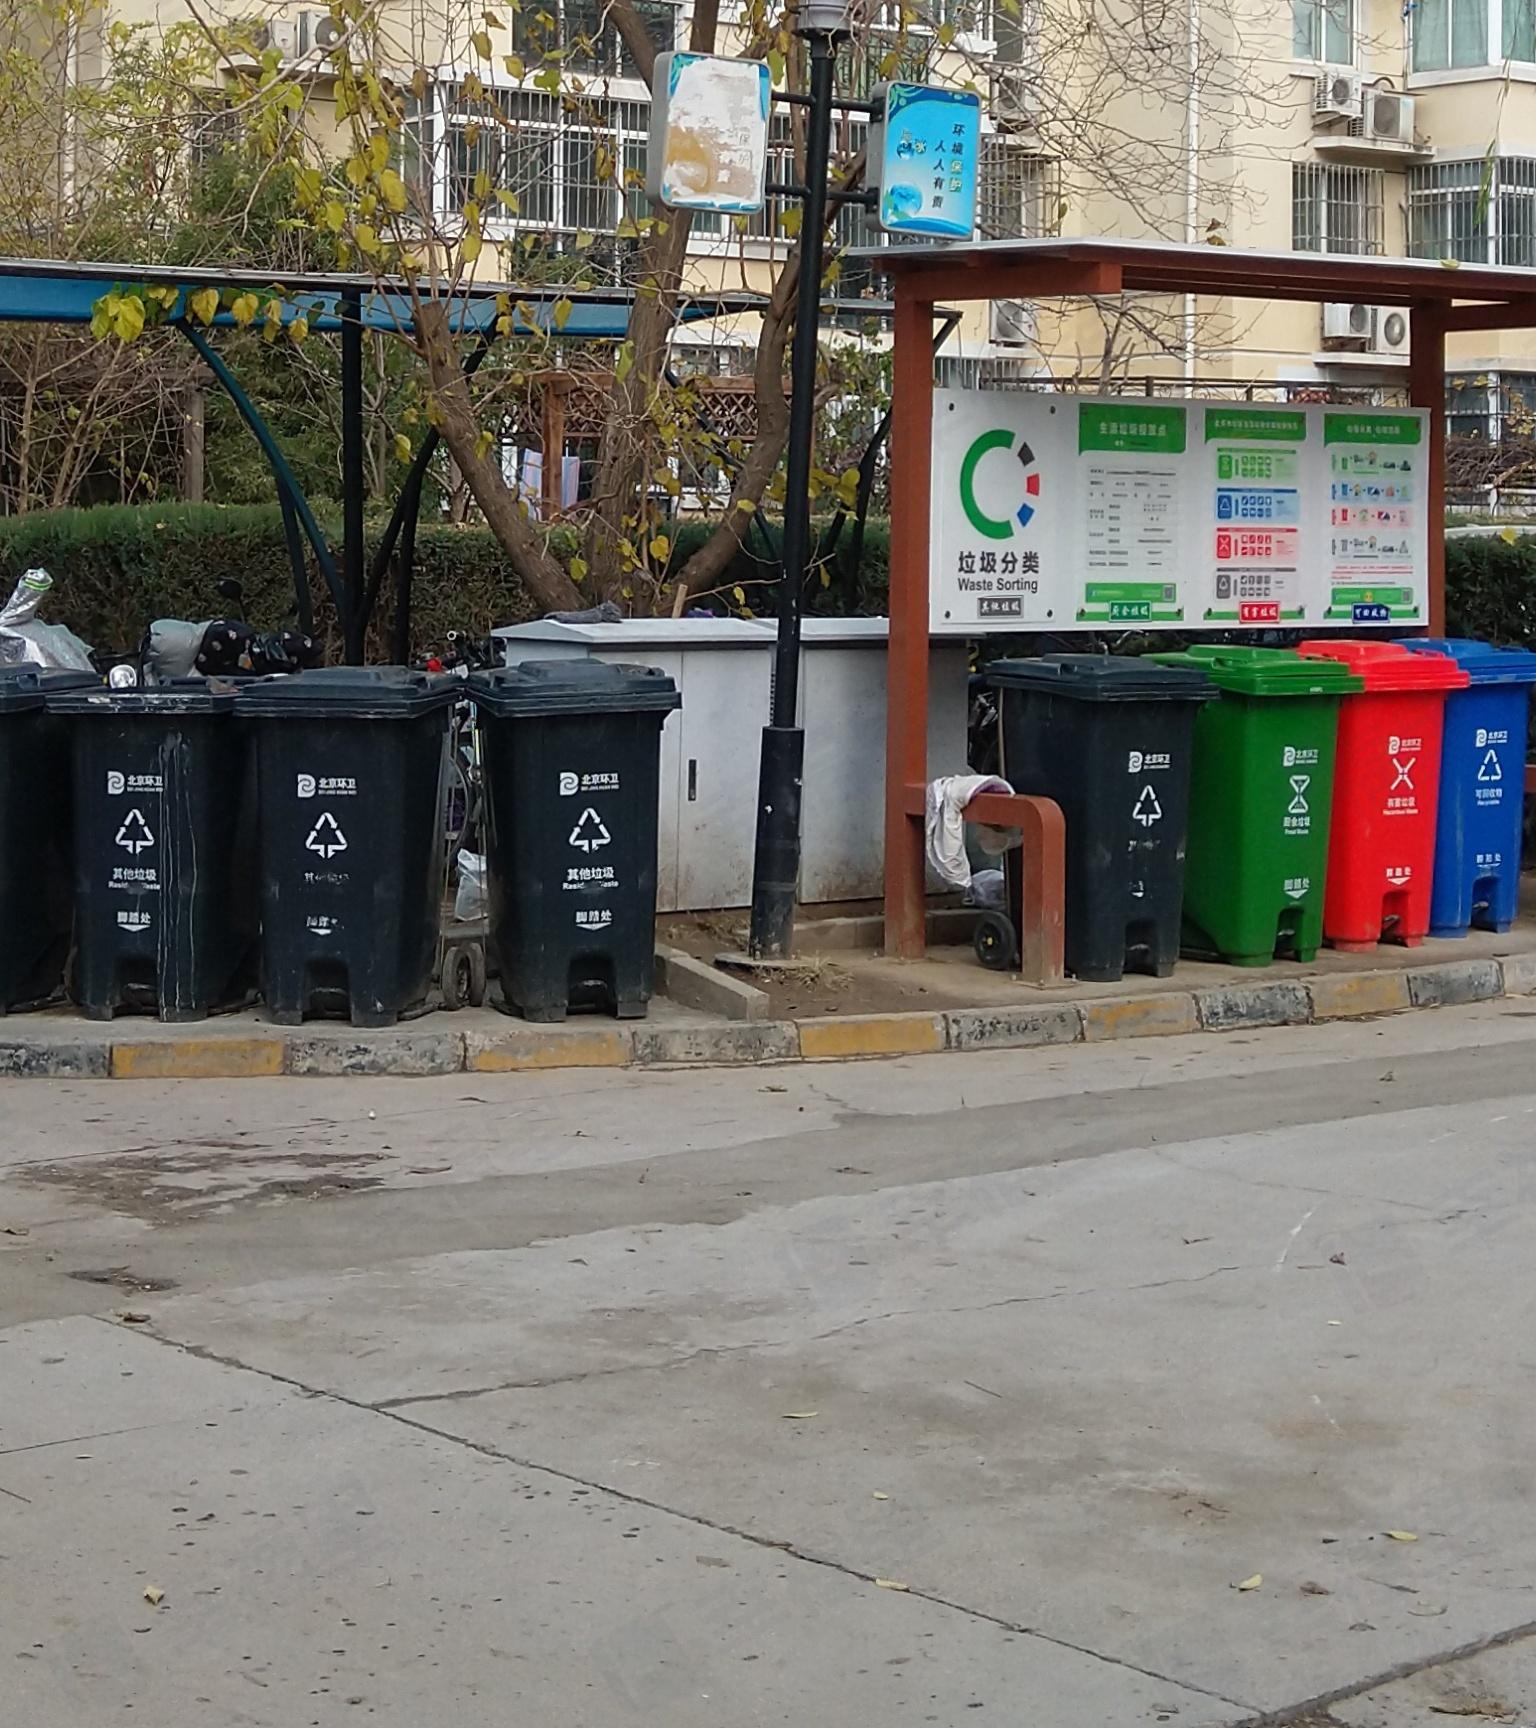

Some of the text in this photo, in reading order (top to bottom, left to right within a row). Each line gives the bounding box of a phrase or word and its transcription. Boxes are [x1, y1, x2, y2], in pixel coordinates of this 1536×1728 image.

[958, 551, 1039, 574] 垃圾分类
[958, 578, 1038, 593] Waste Sorting
[127, 775, 163, 786] 北京环卫
[318, 778, 356, 789] 北京环卫
[581, 773, 620, 785] 北京环卫
[112, 868, 156, 880] 其他垃圾
[567, 866, 614, 881] 其他垃圾
